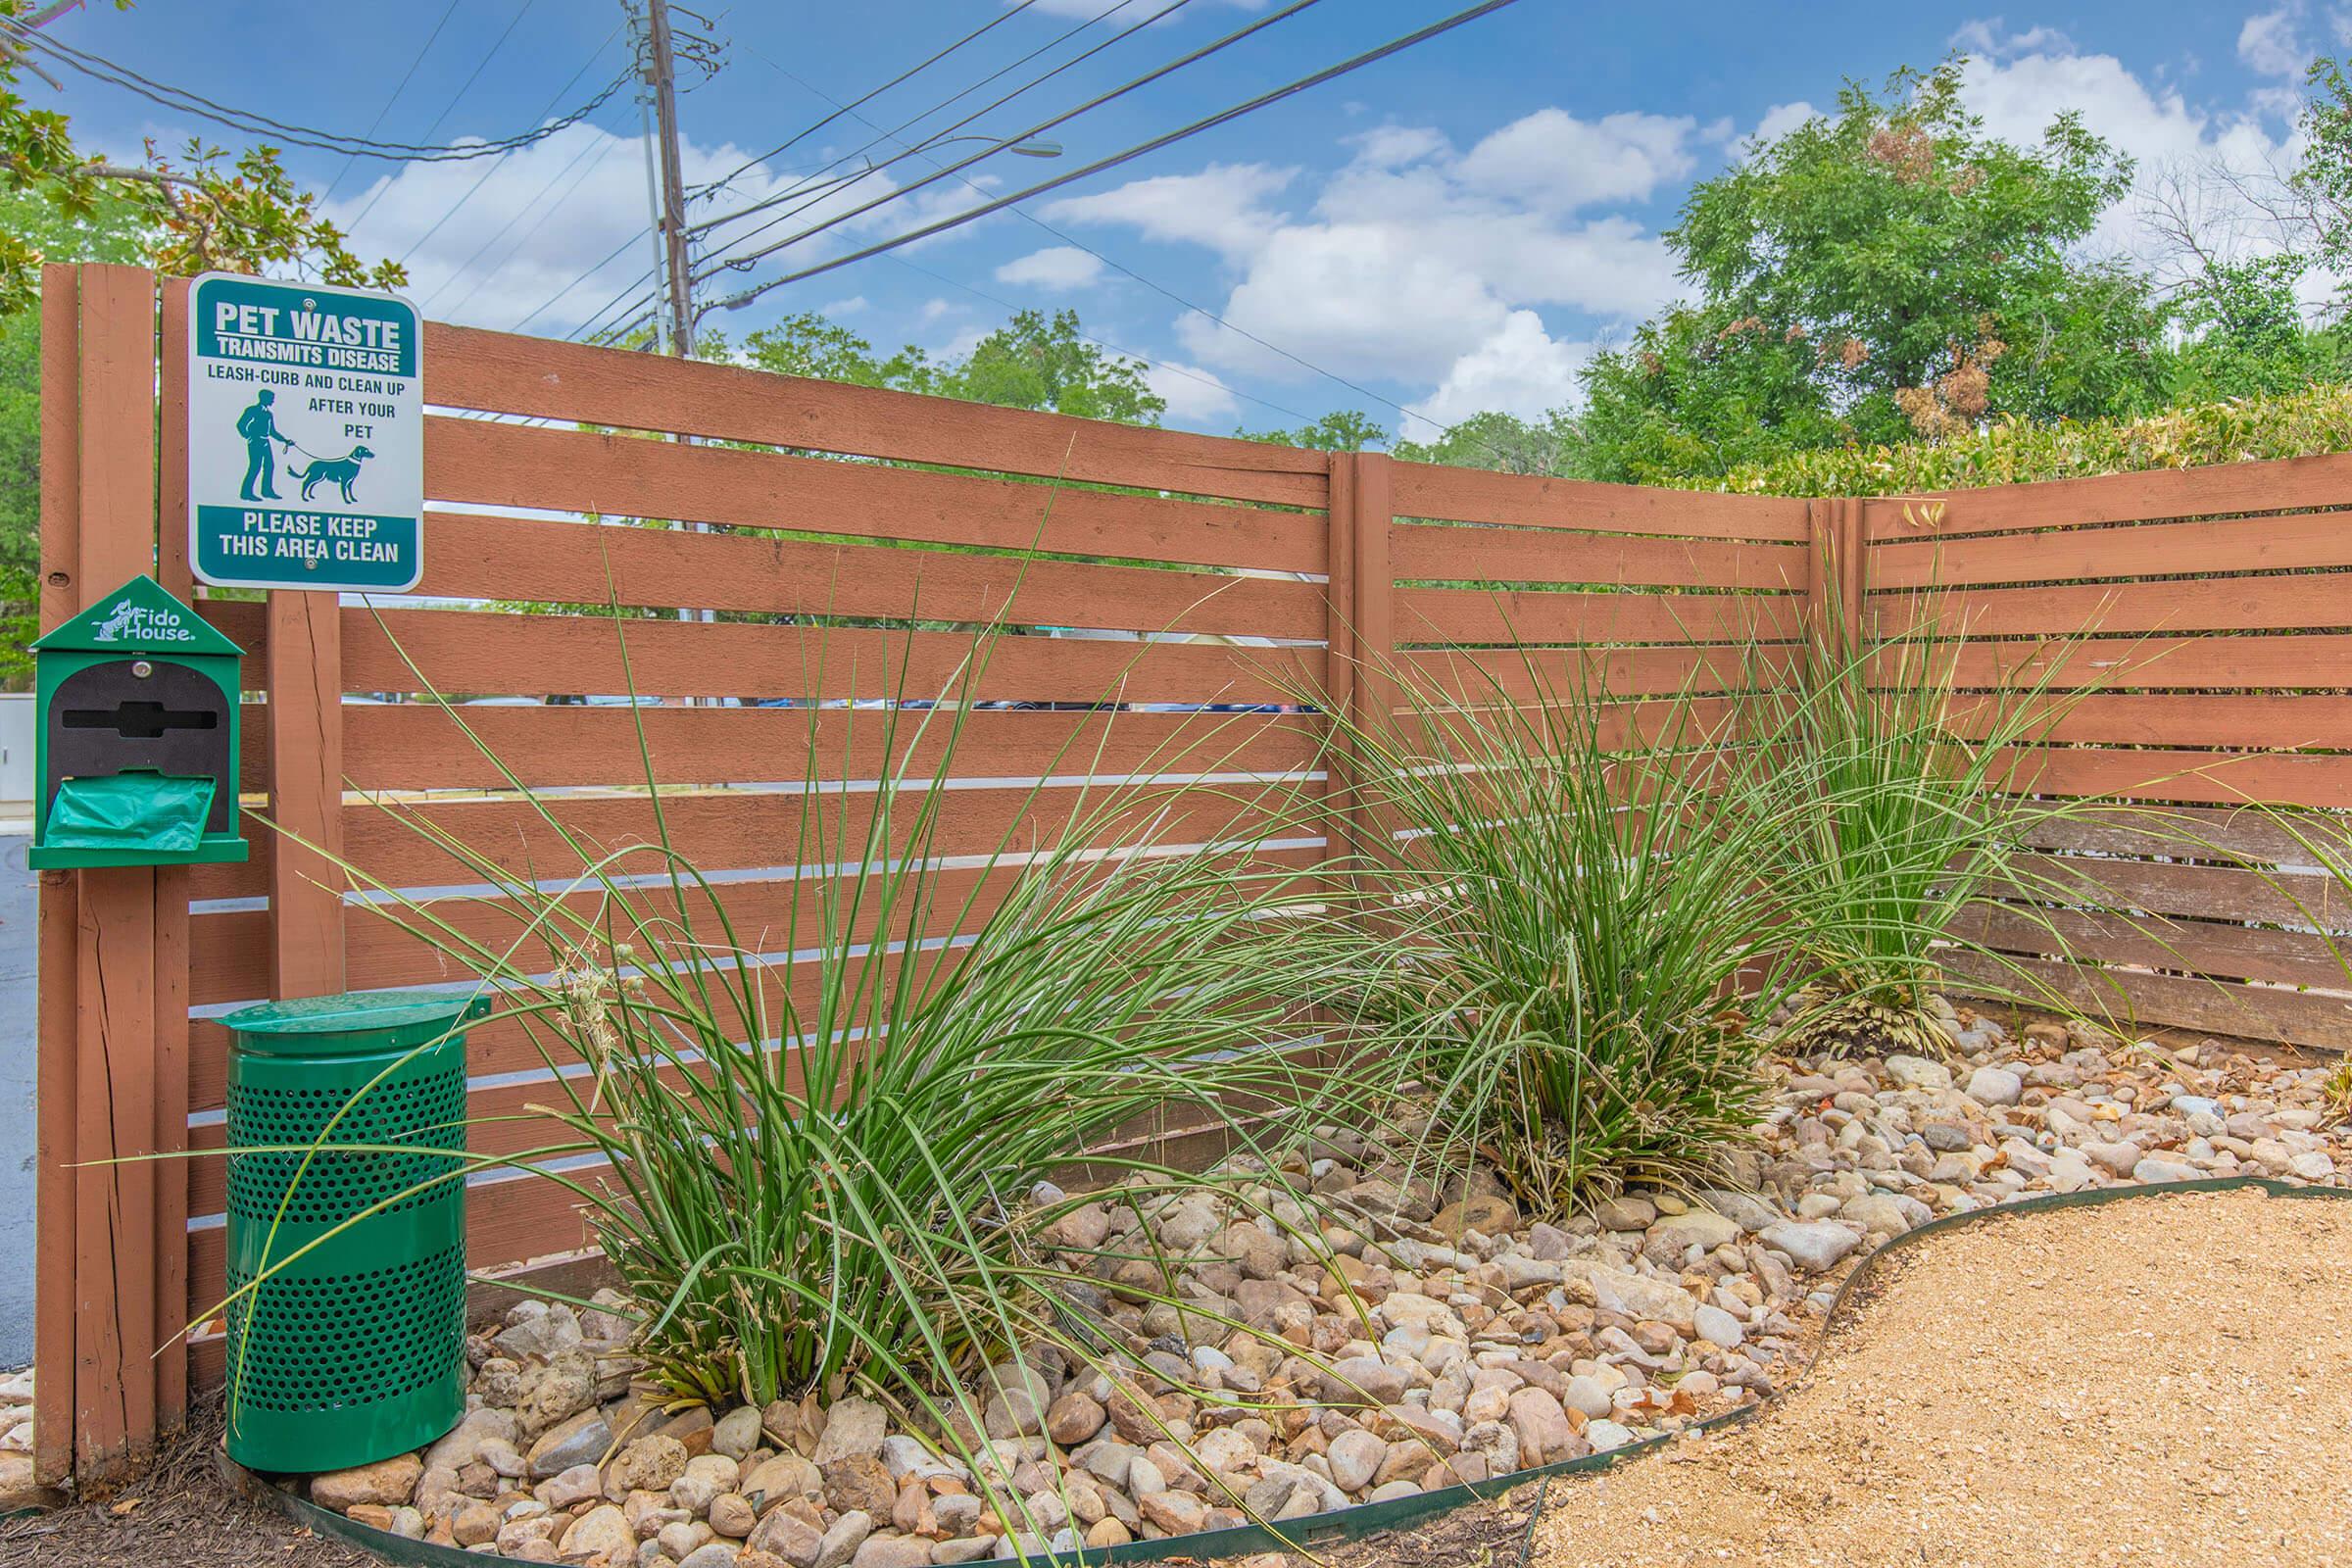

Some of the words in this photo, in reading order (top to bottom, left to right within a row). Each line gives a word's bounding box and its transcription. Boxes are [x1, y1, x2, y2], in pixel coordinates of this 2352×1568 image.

[216, 302, 279, 336] PET
[290, 310, 400, 350] WASTE
[217, 336, 322, 366] TRANSMITS
[328, 349, 400, 372] DISEASE
[208, 364, 299, 386] LEASH-CURB
[305, 374, 333, 389] AND
[338, 377, 382, 394] CLEAN
[387, 382, 405, 396] UP
[309, 398, 354, 415] AFTER
[359, 402, 395, 418] YOUR
[345, 424, 373, 439] PET
[244, 512, 320, 536] PLEASE
[327, 516, 377, 538] KEEP
[220, 534, 268, 557] THIS
[274, 538, 329, 560] AREA
[335, 541, 398, 563] CLEAN
[132, 608, 180, 626] Fido
